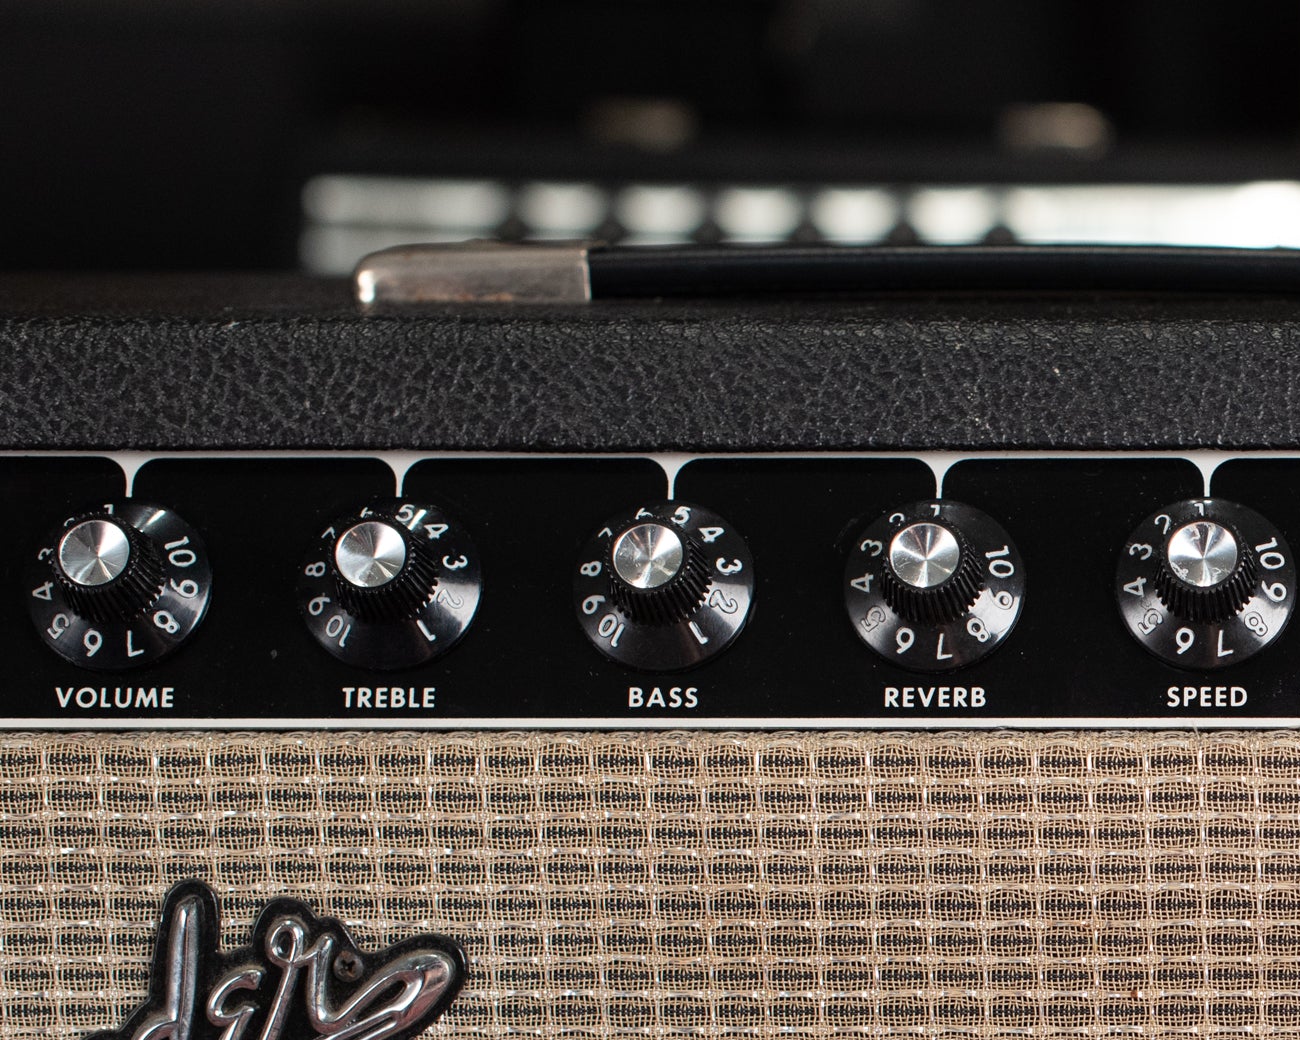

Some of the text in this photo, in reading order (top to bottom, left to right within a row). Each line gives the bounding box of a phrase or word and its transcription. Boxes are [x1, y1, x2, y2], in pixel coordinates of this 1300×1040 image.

[395, 504, 415, 522] 5
[670, 506, 691, 525] 5
[424, 523, 449, 539] 4
[699, 526, 725, 543] 4
[164, 536, 197, 567] 10
[860, 539, 882, 557] 3
[1129, 543, 1152, 560] 3
[1255, 537, 1285, 570] 10
[305, 562, 326, 577] 8
[442, 555, 468, 570] 3
[580, 561, 602, 577] 8
[716, 557, 743, 575] 3
[985, 545, 1014, 578] 10
[32, 581, 54, 600] 4
[170, 578, 198, 598] 9
[850, 573, 874, 593] 4
[1123, 577, 1147, 598] 4
[1261, 580, 1287, 603] 9
[438, 589, 464, 609] 2
[582, 595, 606, 615] 9
[710, 589, 738, 614] 2
[47, 613, 70, 640] 5
[153, 610, 180, 634] 8
[860, 605, 886, 632] 5
[1138, 608, 1163, 636] 5
[1244, 611, 1268, 637] 8
[326, 615, 351, 648] 10
[416, 619, 436, 642] 1
[598, 613, 625, 648] 10
[688, 621, 708, 645] 1
[896, 627, 915, 654] 6
[967, 618, 991, 642] 8
[1176, 627, 1195, 655] 6
[84, 629, 102, 657] 6
[127, 630, 144, 658] 7
[937, 633, 952, 660] 7
[1217, 629, 1234, 658] 7
[56, 688, 173, 708] VOLUME
[343, 688, 435, 707] TREBLE
[629, 688, 697, 707] BASS
[885, 687, 985, 707] REVERB
[1168, 687, 1247, 707] SPEED
